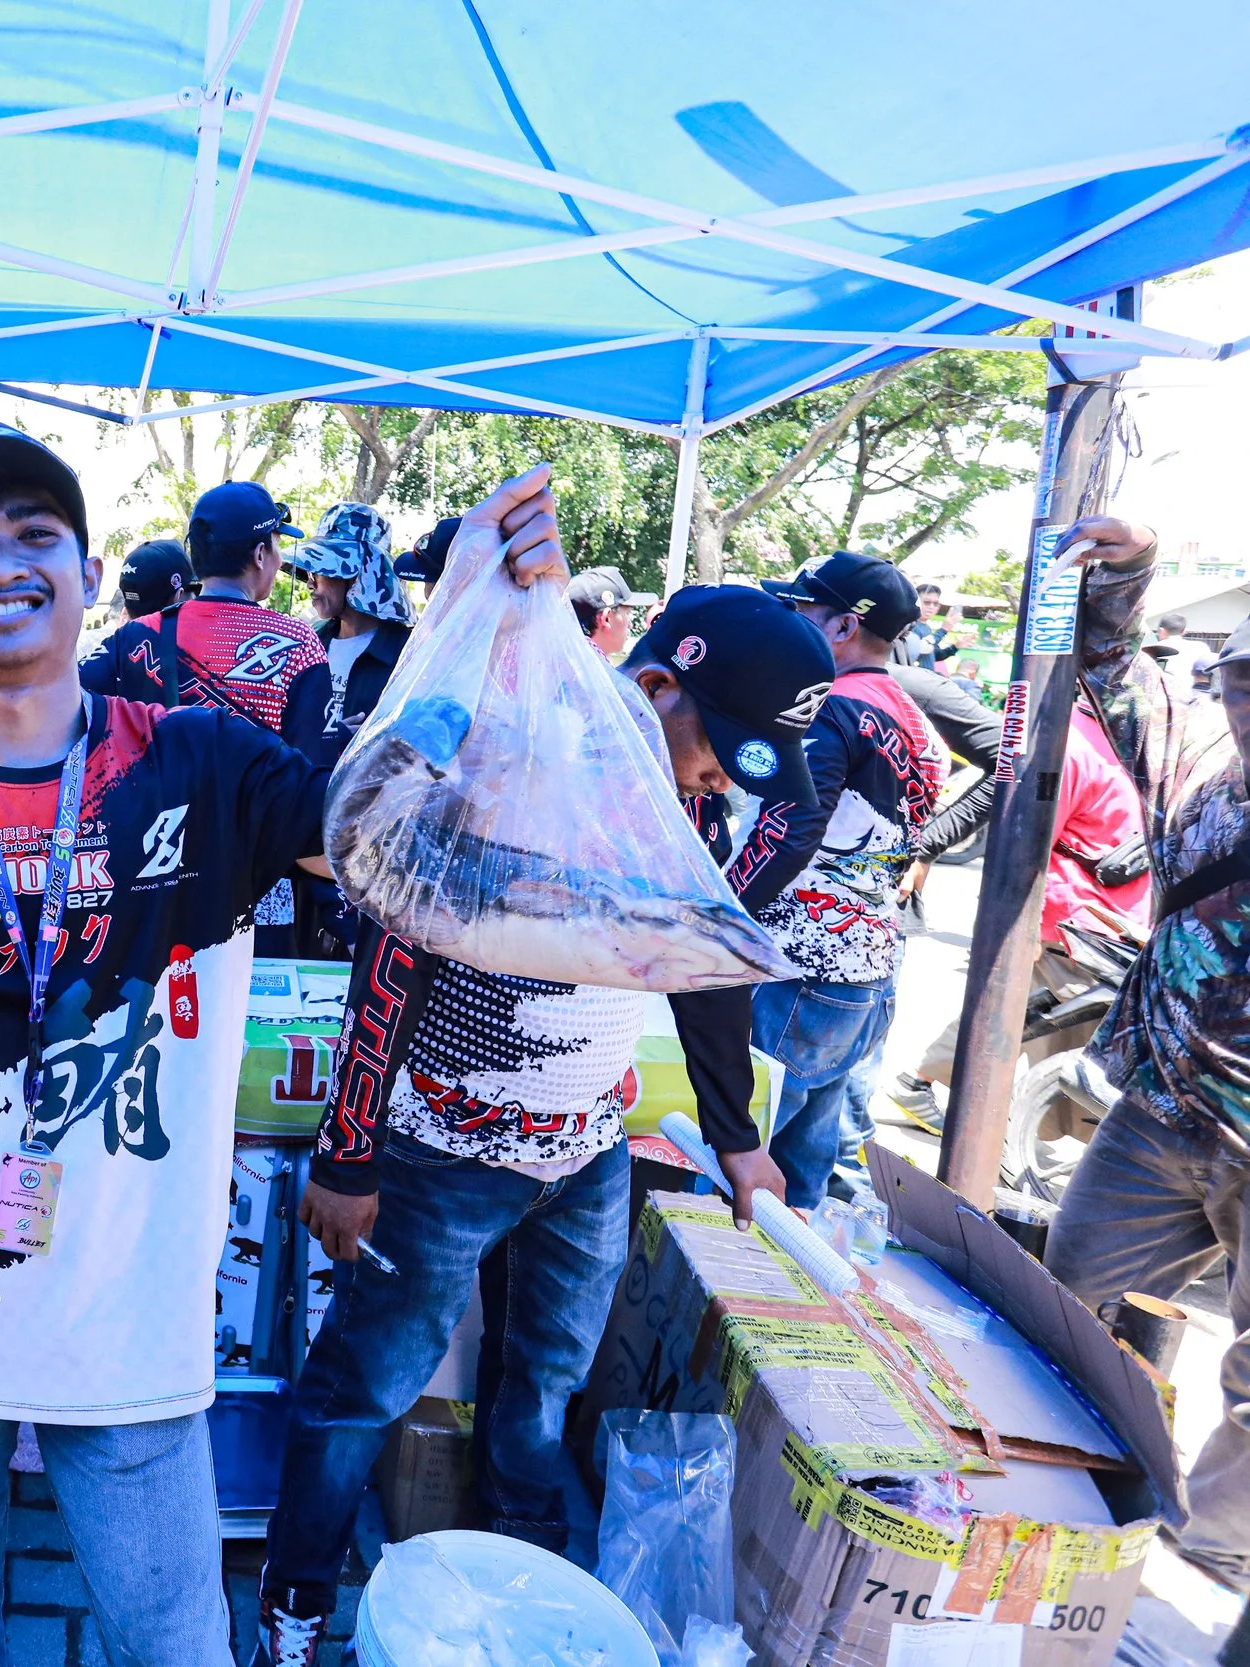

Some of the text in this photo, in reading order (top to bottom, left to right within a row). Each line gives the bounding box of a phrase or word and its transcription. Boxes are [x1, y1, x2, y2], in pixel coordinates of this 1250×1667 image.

[1031, 551, 1040, 601] SERVICE
[1033, 616, 1075, 652] 0813
[66, 749, 84, 807] NUTICA
[0, 835, 108, 853] Carbon Toament
[47, 864, 64, 927] BULLET
[66, 890, 114, 909] 827
[334, 930, 414, 1162] UTICA
[18, 1157, 40, 1166] Member
[233, 1154, 267, 1184] alifornia
[0, 1199, 39, 1212] NUTICA
[17, 1237, 47, 1249] BULLET
[857, 1520, 939, 1555] PANCING
